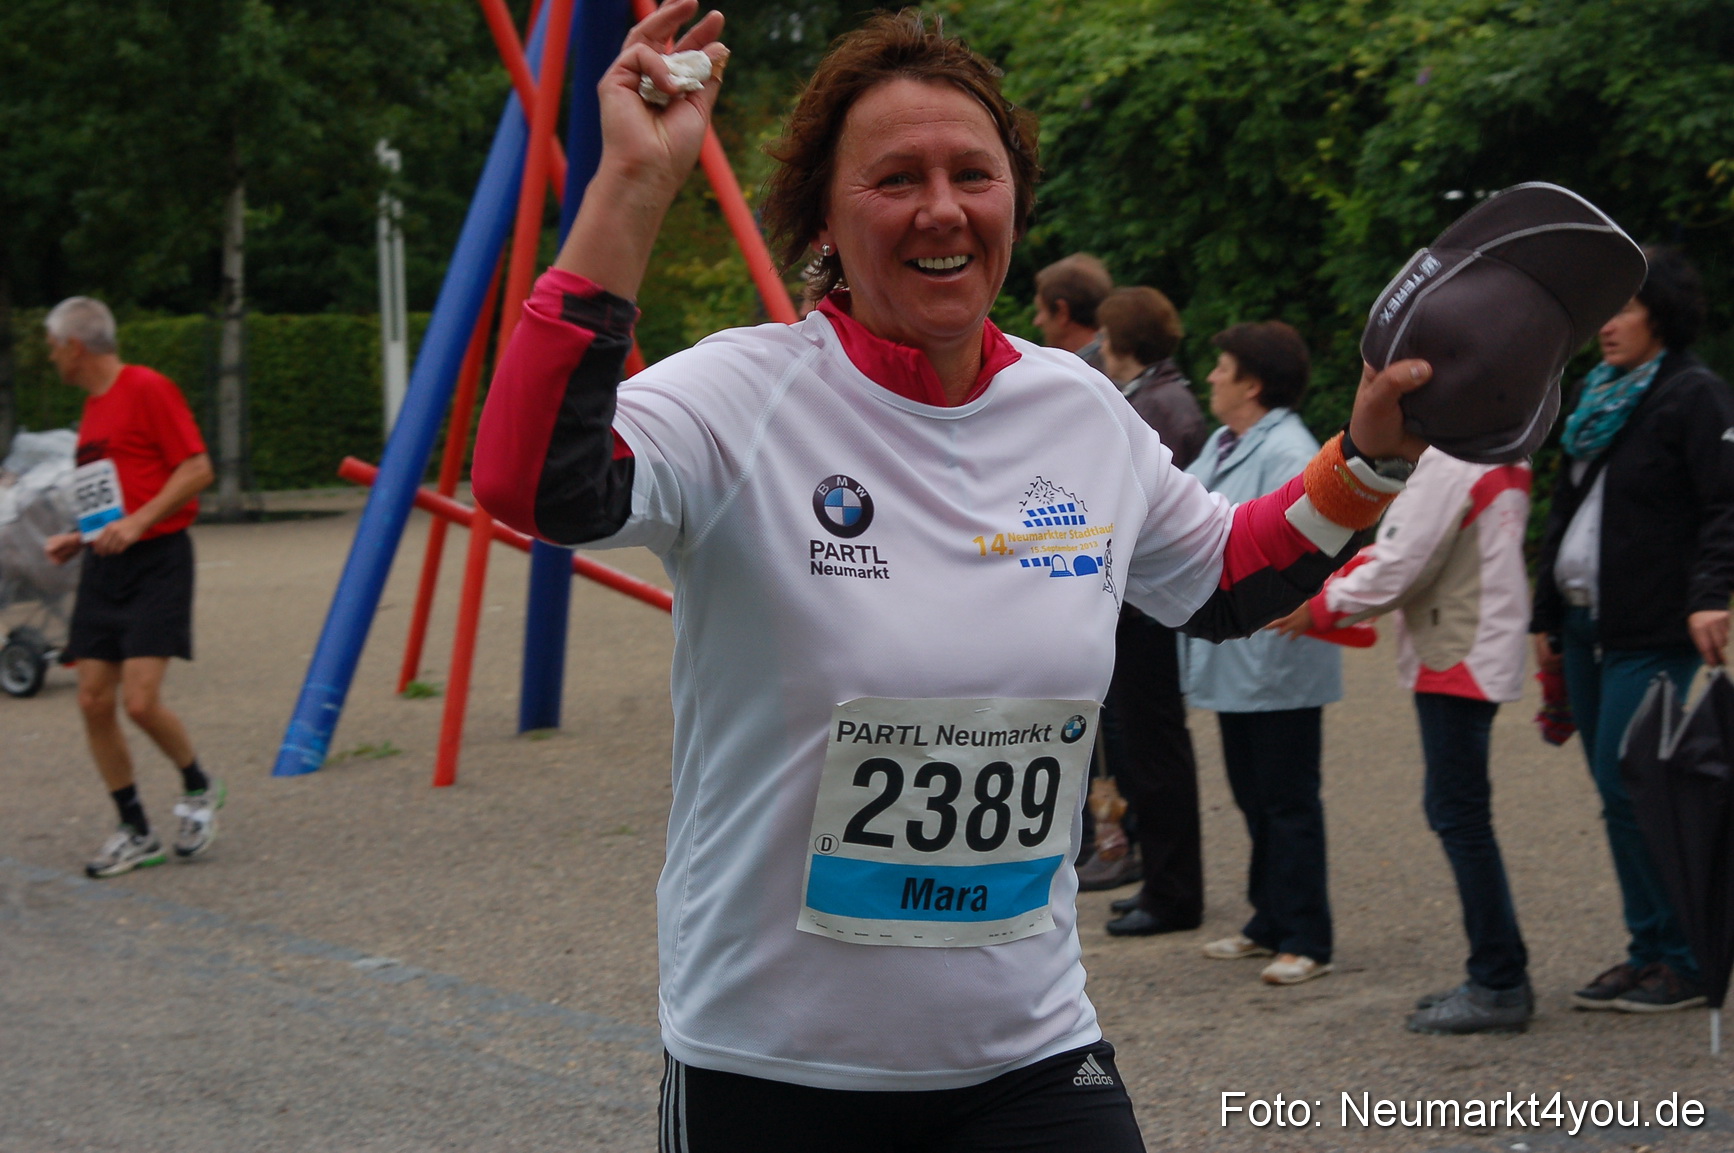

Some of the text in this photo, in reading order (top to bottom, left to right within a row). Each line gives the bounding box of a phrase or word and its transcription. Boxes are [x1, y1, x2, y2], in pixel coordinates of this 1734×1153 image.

[810, 539, 888, 566] PARTL
[972, 522, 1114, 556] 14. Neumarkter Stadtlauf
[1080, 541, 1099, 551] 2013
[810, 561, 890, 580] Neumarkt
[836, 720, 1053, 747] PARTL Neumarkt
[842, 756, 1062, 853] 2389
[901, 877, 988, 912] Mara
[1073, 1074, 1113, 1086] adidas
